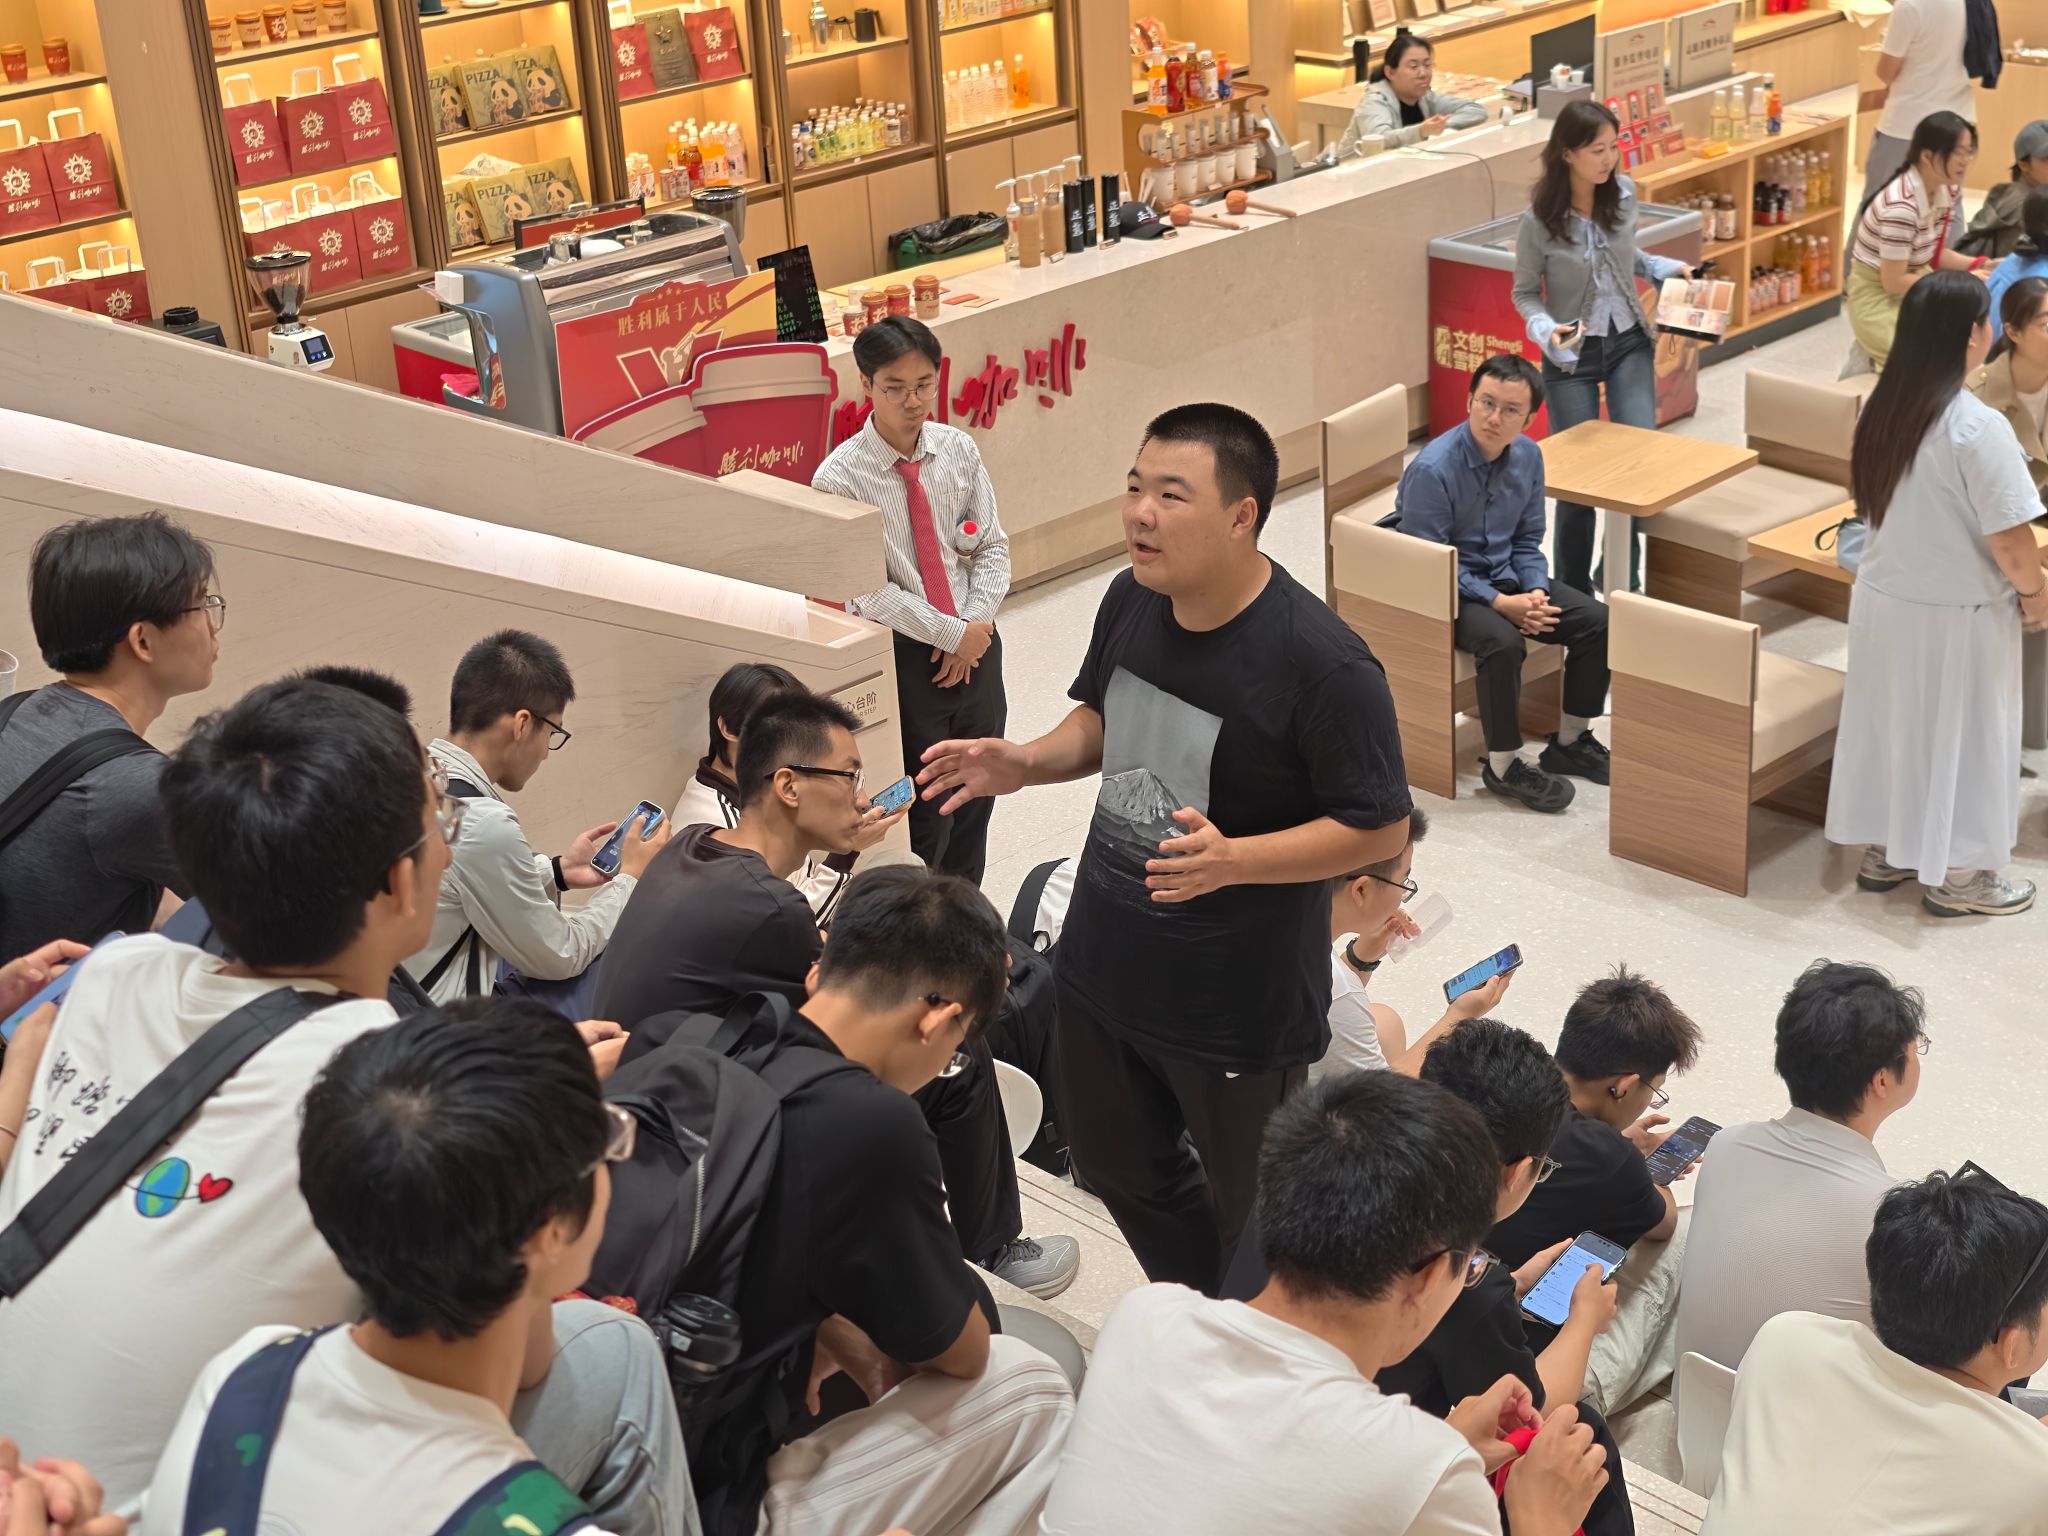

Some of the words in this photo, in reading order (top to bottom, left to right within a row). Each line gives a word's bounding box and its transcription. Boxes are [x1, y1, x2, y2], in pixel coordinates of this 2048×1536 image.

[466, 68, 501, 85] PIZZA
[477, 183, 514, 200] PIZZA
[618, 291, 723, 337] 胜利属于人民
[1452, 330, 1485, 354] 文创
